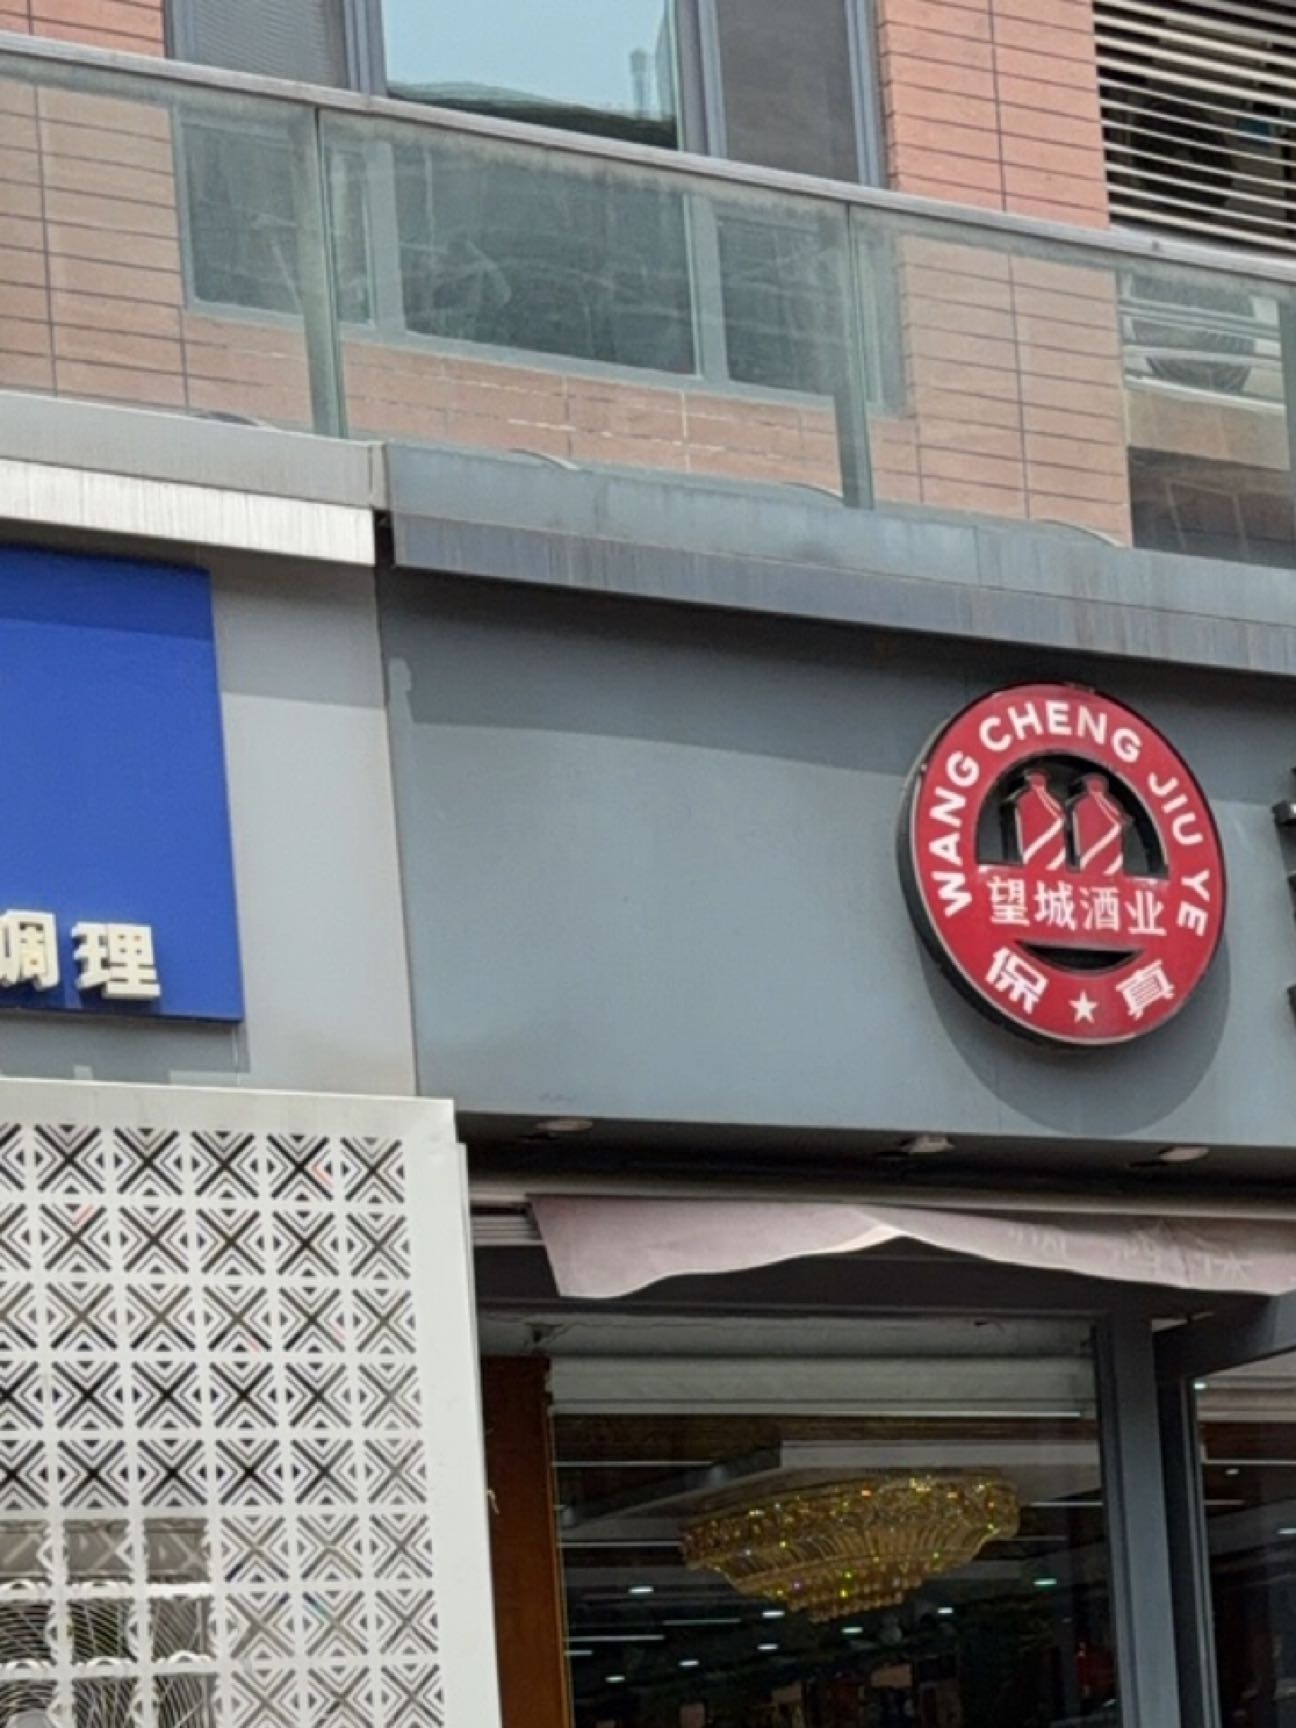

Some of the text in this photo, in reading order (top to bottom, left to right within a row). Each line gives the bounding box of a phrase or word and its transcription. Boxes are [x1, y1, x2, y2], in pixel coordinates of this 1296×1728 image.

[928, 699, 1211, 937] WANG CHENG JIU YE
[987, 876, 1168, 936] 望城酒业
[0, 908, 161, 1000] 调理
